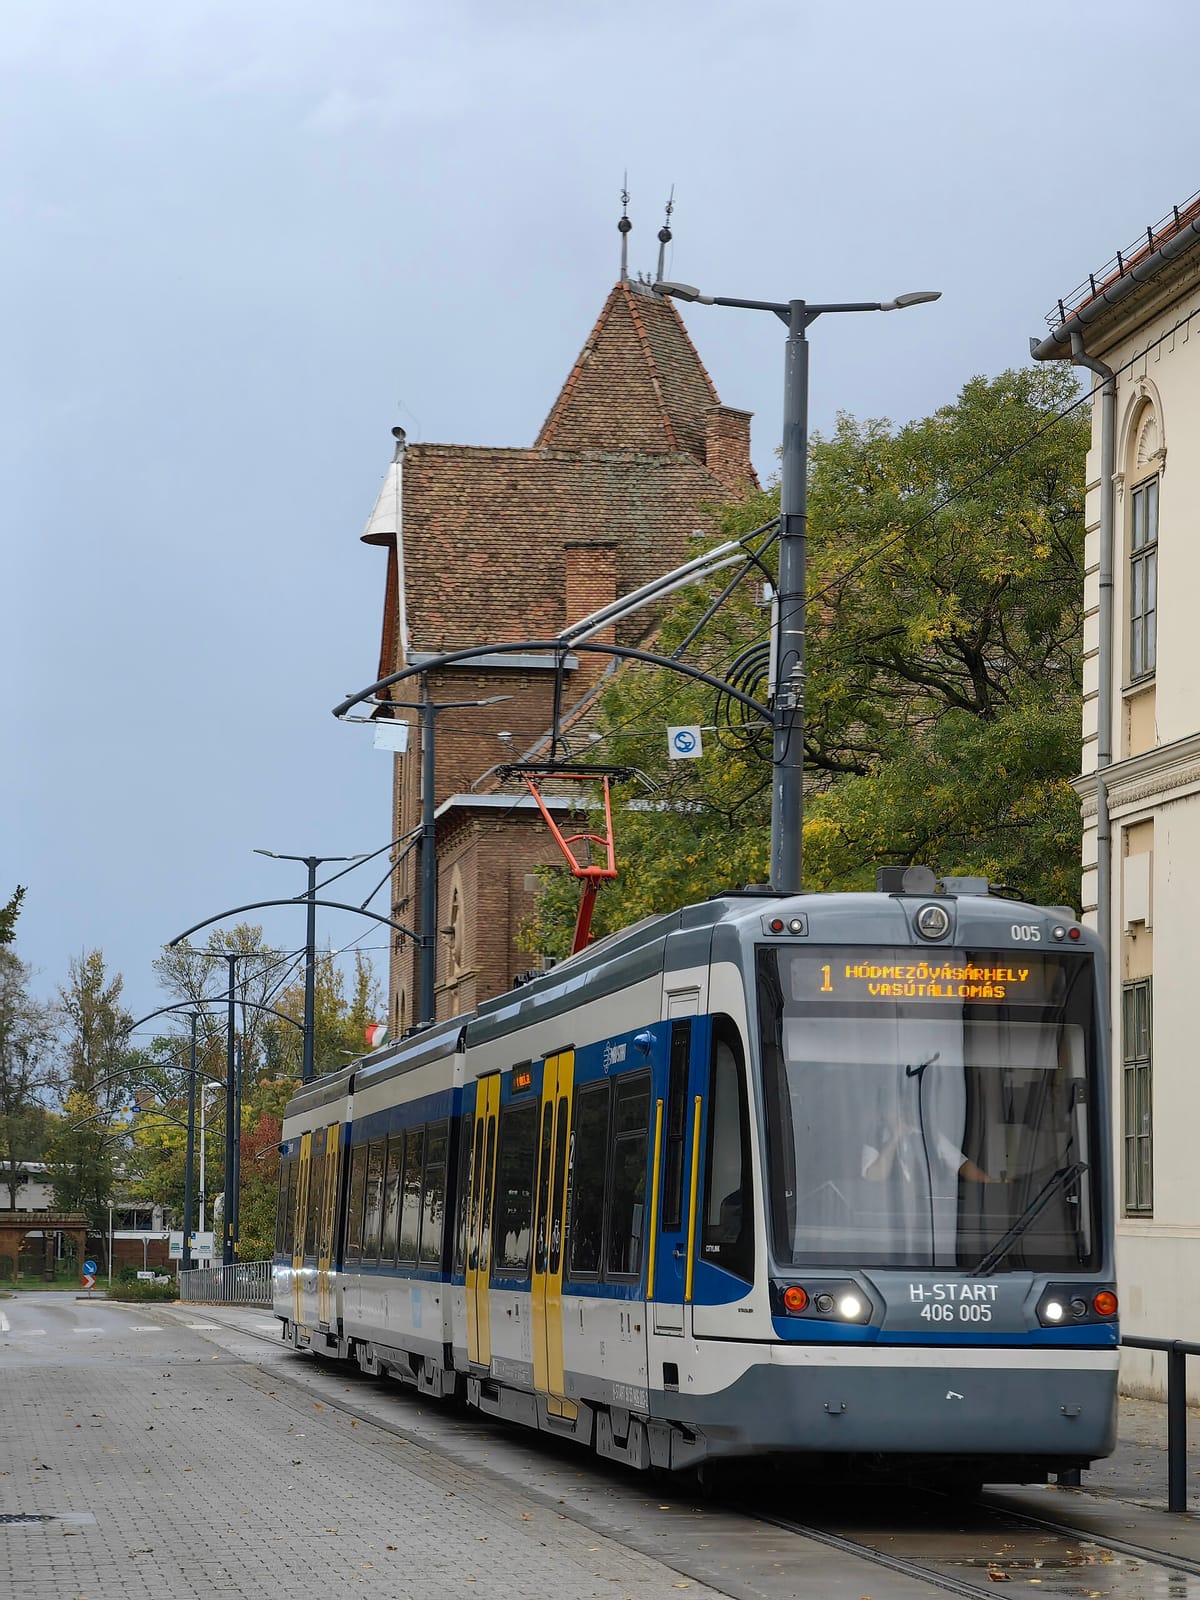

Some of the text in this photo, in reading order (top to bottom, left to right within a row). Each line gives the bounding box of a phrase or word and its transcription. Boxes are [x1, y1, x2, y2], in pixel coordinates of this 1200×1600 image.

[1010, 924, 1041, 941] 005
[819, 965, 834, 992] 1
[845, 961, 1030, 982] HÓDMEZŐVÁSÁRHELY
[867, 980, 1007, 999] VASÚTÁLLOMÁS
[909, 1283, 999, 1303] H-START
[920, 1303, 993, 1322] 406 005
